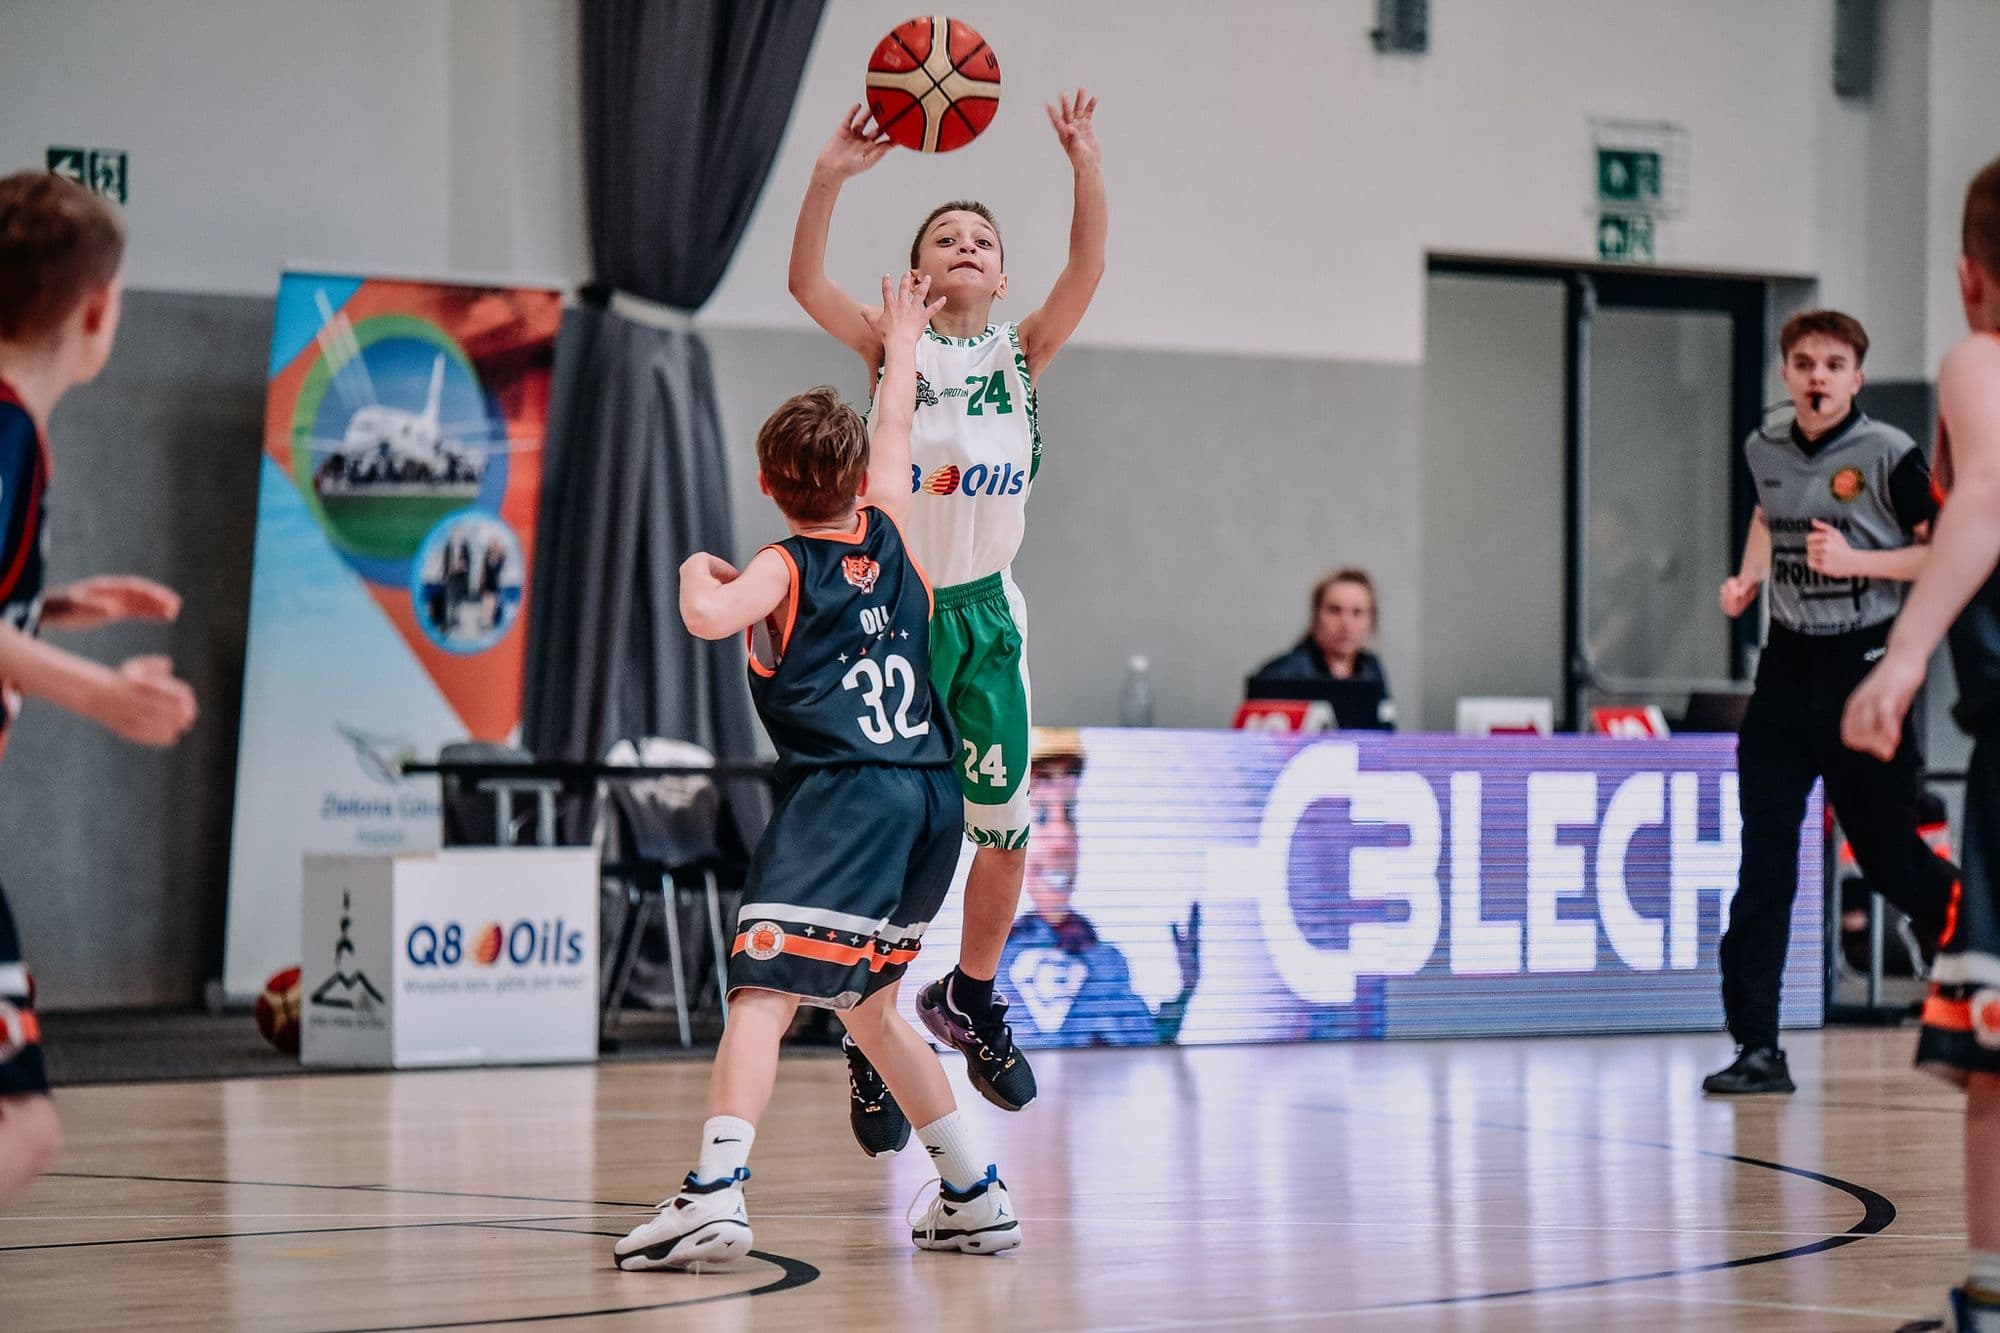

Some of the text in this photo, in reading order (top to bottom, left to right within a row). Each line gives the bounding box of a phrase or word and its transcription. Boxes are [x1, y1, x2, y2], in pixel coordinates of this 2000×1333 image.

[965, 370, 1013, 415] 24
[961, 462, 1025, 497] Oils
[841, 654, 930, 744] 32
[962, 738, 1008, 787] 24
[407, 917, 583, 967] Q8 Oils
